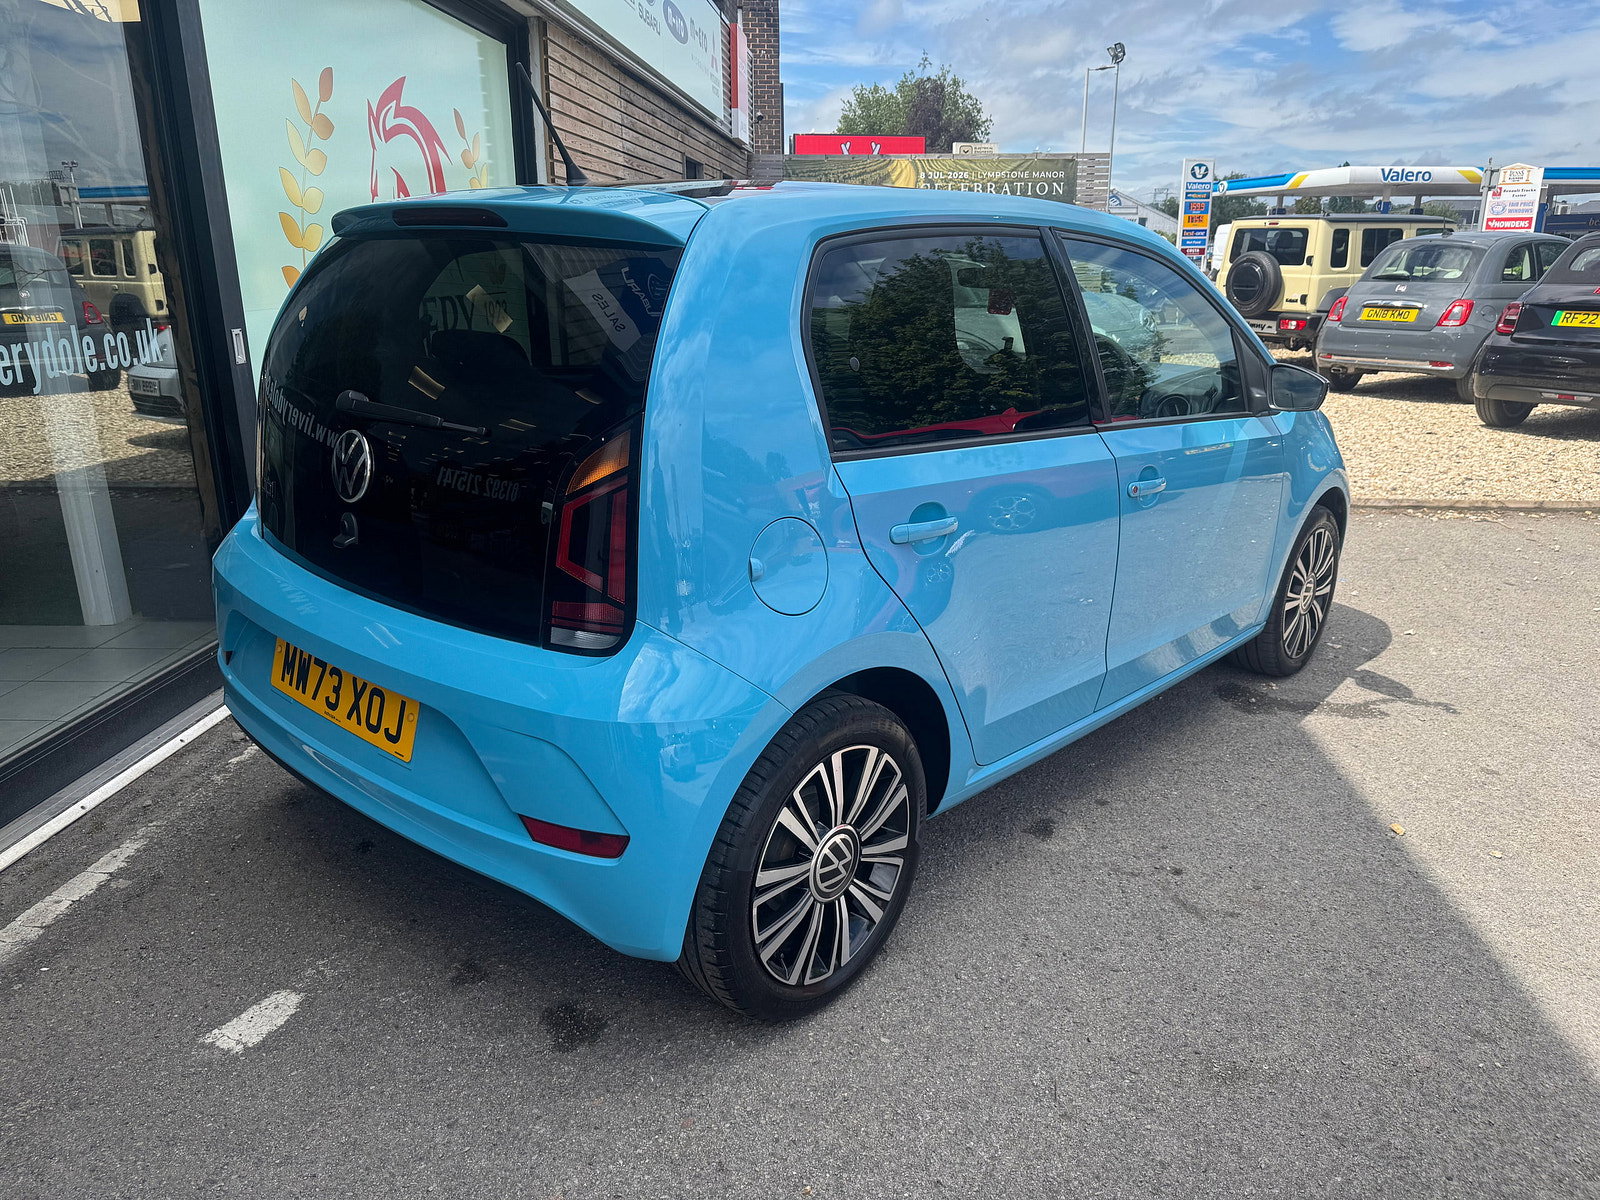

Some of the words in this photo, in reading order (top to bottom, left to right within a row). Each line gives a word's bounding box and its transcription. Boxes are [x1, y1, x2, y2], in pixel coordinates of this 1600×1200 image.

[977, 171, 1030, 179] LYMPSTONE
[1381, 168, 1432, 182] Valero
[1187, 182, 1211, 190] Valero
[1495, 220, 1530, 228] HOWDENS
[1366, 309, 1389, 319] GN18
[1390, 310, 1411, 320] KMO
[1561, 312, 1600, 325] RF22
[0, 317, 163, 394] erydole.co.uk
[280, 641, 343, 712] MW73
[346, 676, 407, 745] XOJ
